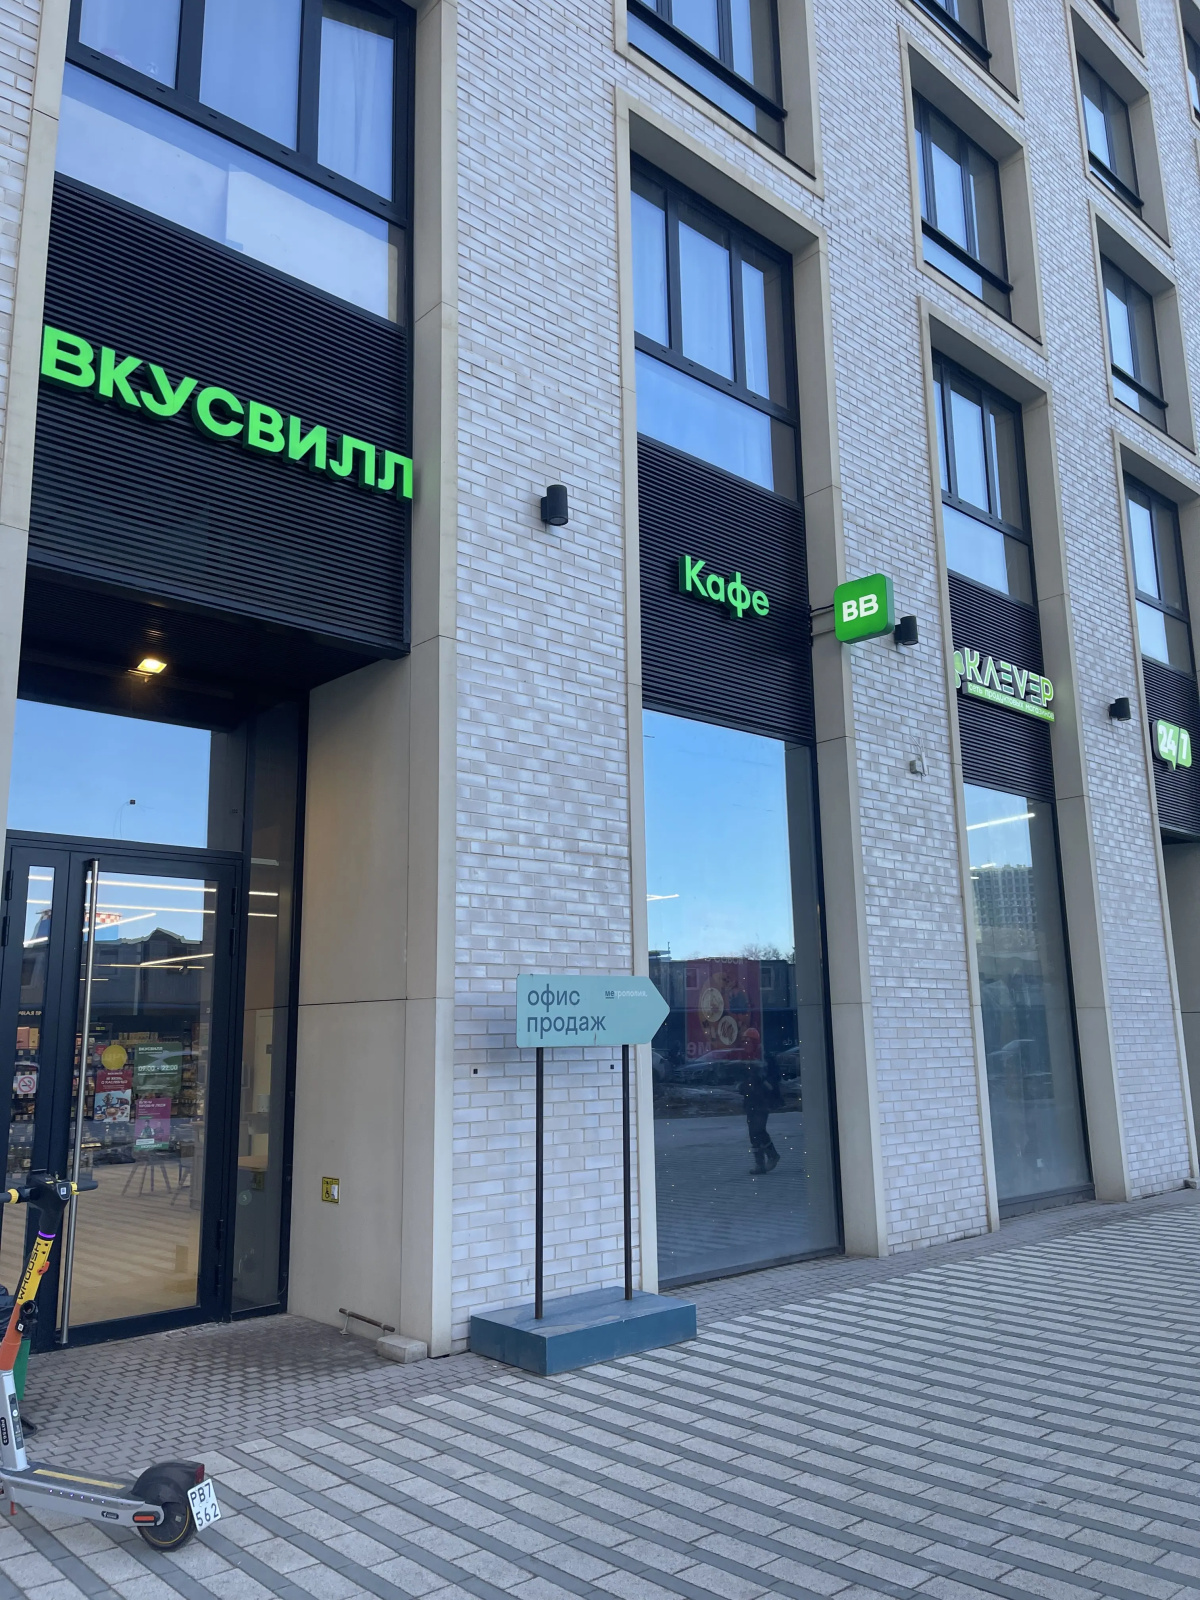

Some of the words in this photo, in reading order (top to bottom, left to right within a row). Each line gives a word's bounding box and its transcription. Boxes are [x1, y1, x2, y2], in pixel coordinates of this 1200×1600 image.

[40, 324, 413, 500] ВКУСВИЛЛ
[683, 554, 770, 619] Кафе
[527, 983, 581, 1013] офис
[527, 1015, 607, 1039] продаж
[18, 1241, 42, 1300] WHOOSH
[195, 1502, 219, 1527] 562
